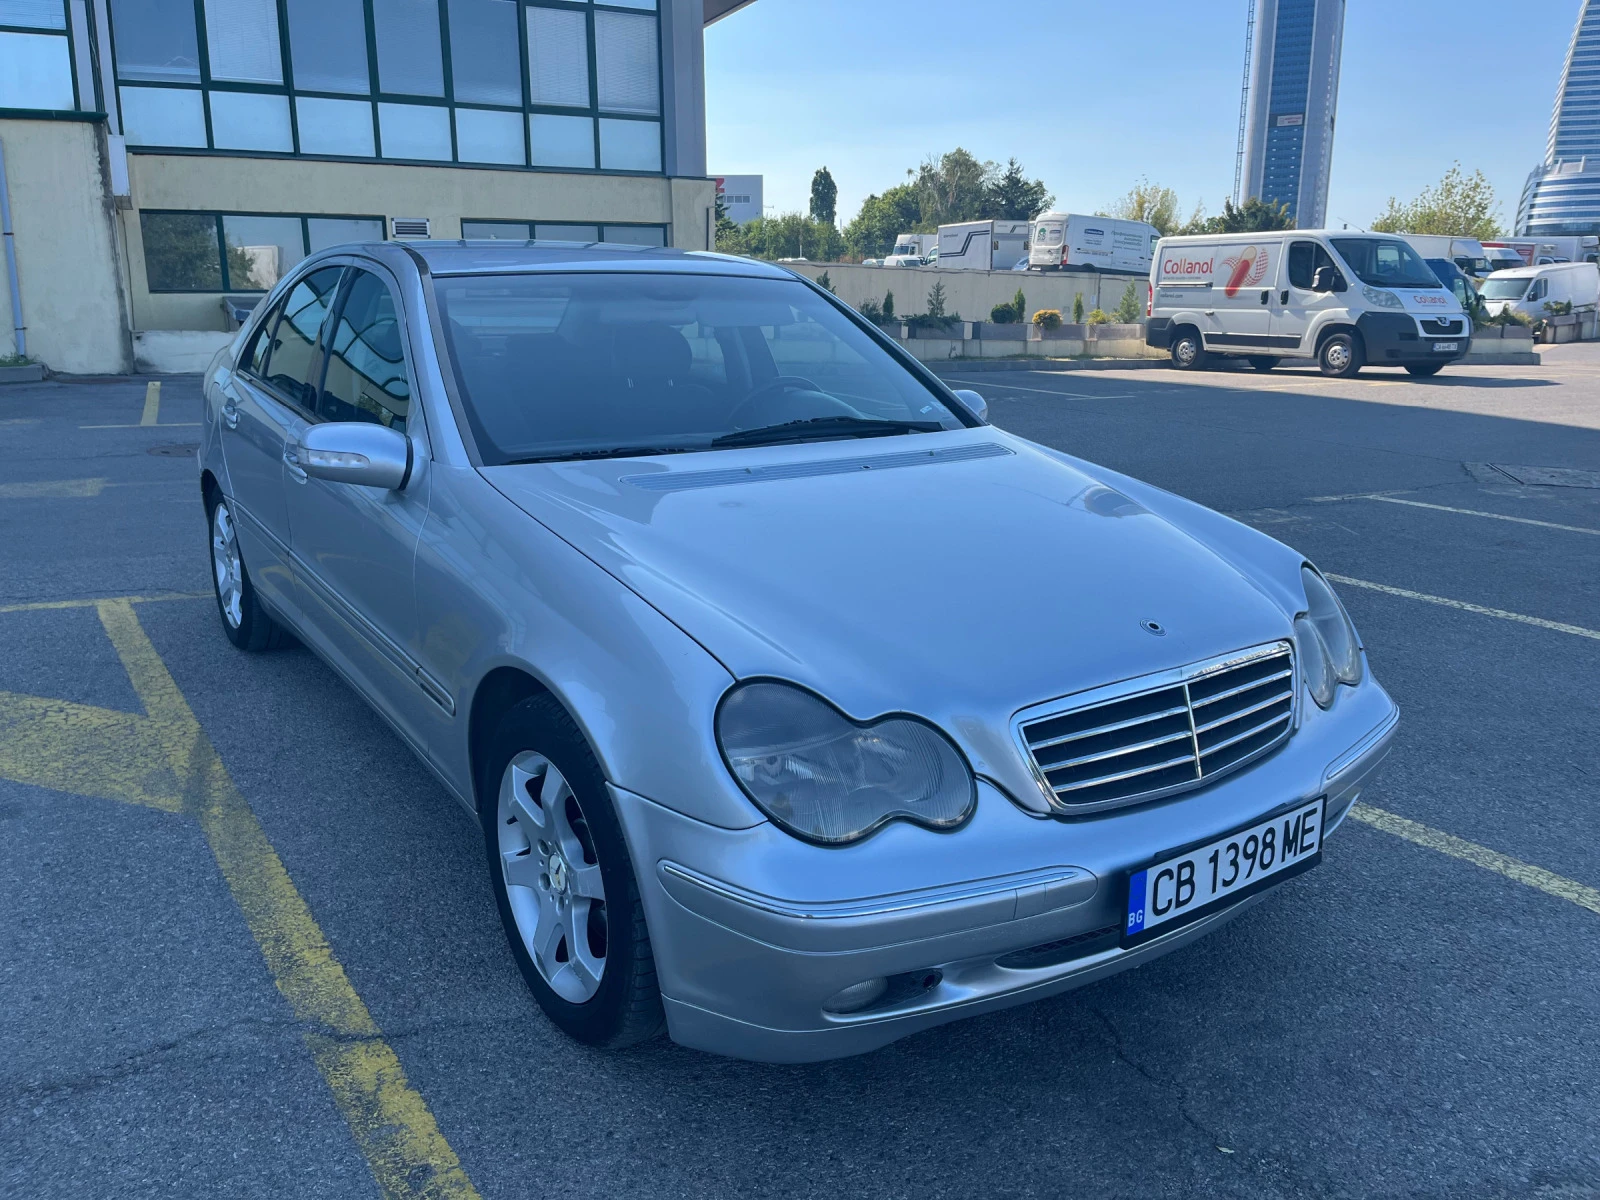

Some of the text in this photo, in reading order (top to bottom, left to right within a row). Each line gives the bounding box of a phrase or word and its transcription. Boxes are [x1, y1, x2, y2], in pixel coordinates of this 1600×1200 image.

[1164, 258, 1214, 274] Collanol
[1152, 807, 1318, 917] CB 1398 ME
[1128, 909, 1143, 927] BG
